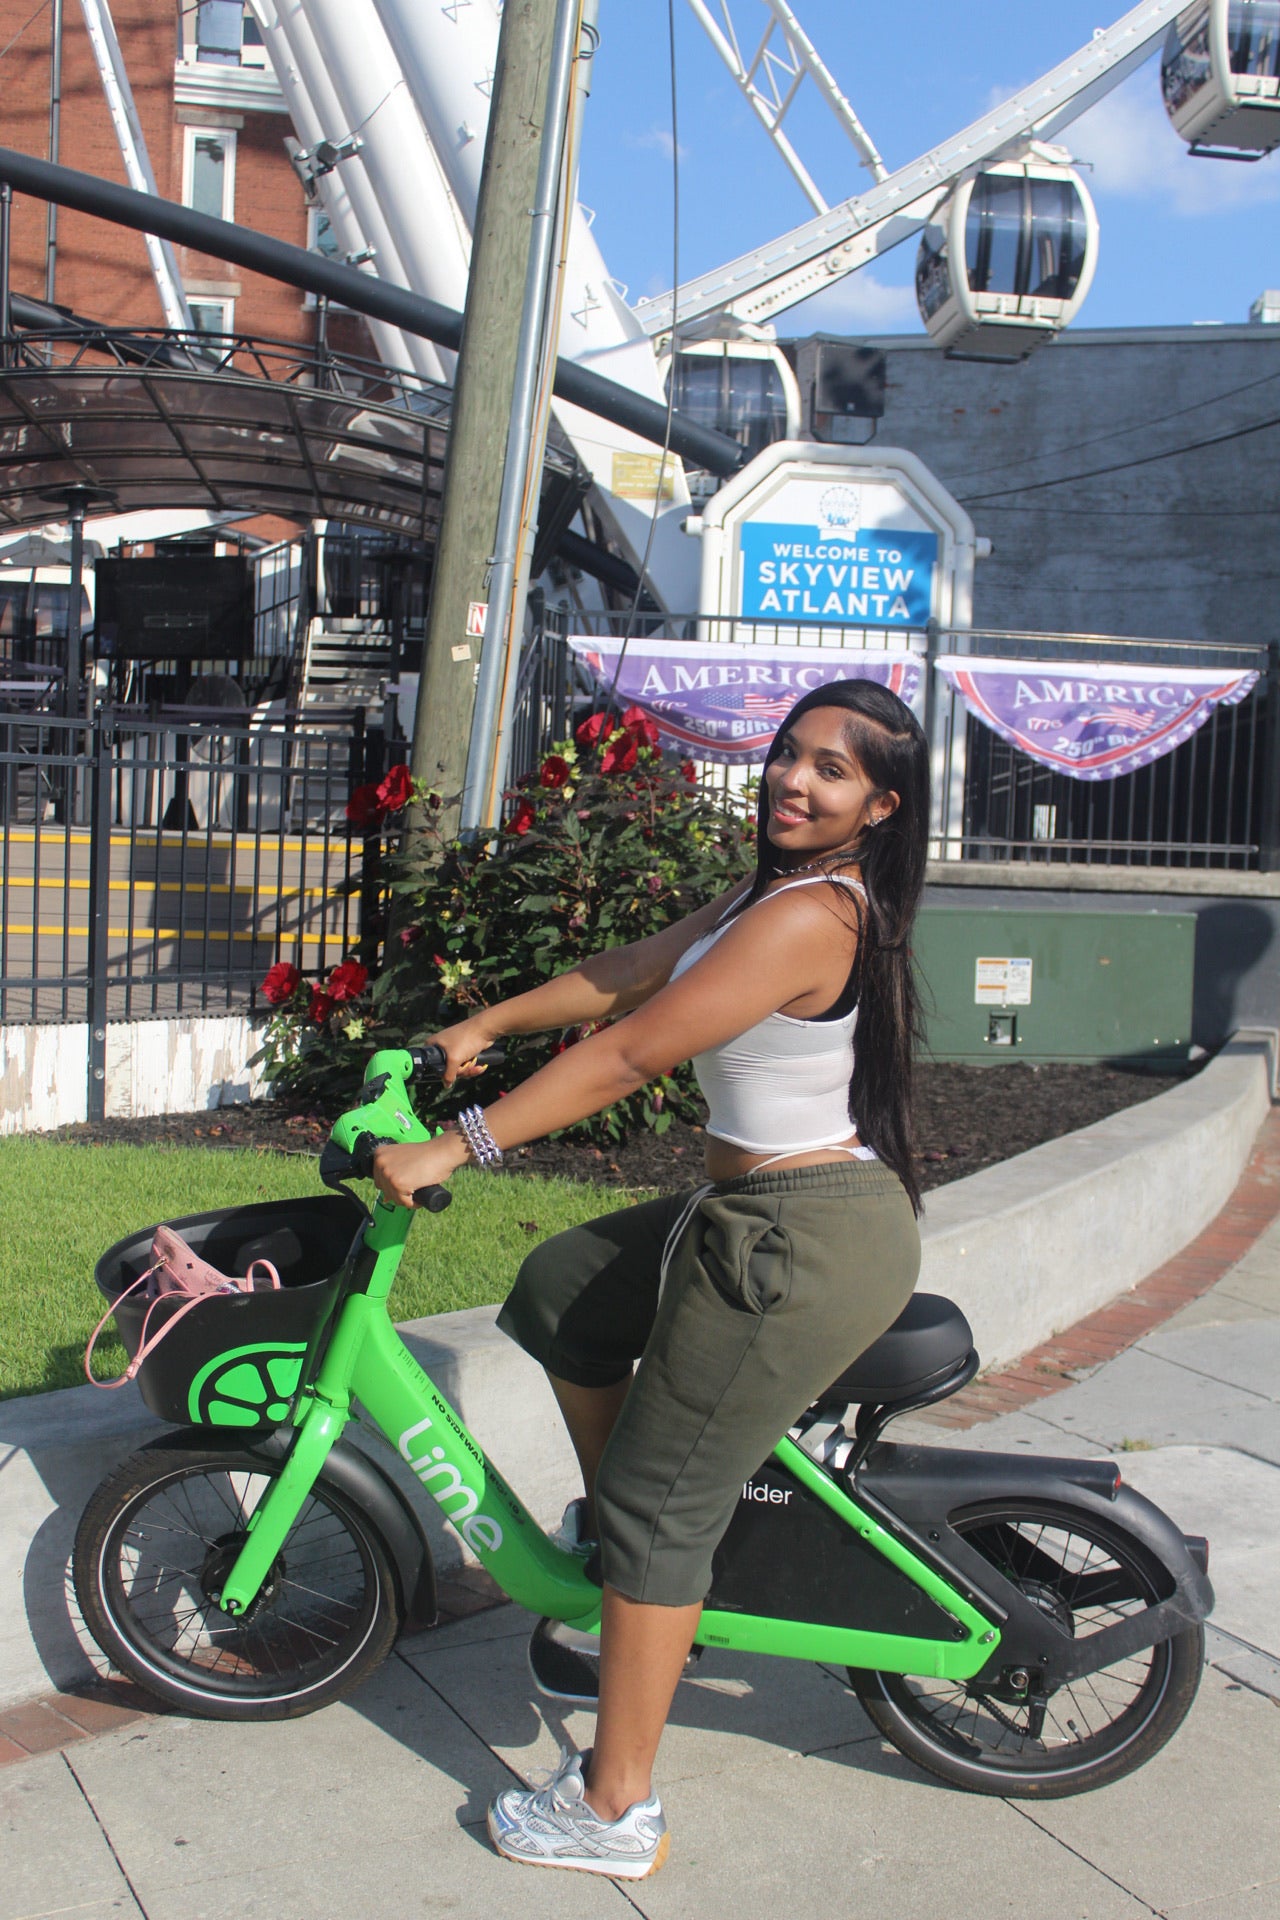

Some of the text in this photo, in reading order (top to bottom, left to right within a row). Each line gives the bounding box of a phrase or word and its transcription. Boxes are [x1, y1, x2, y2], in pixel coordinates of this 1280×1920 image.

[773, 543, 902, 564] WELCOME TO
[758, 561, 914, 592] SKYVIEW
[759, 589, 911, 619] ATLANTA
[472, 606, 488, 633] N
[1013, 679, 1196, 709] AMERICA
[1027, 717, 1063, 731] 1776
[431, 1394, 445, 1414] NO
[446, 1414, 490, 1473] SIDEWALK
[399, 1417, 503, 1553] Lime
[742, 1481, 793, 1504] lider
